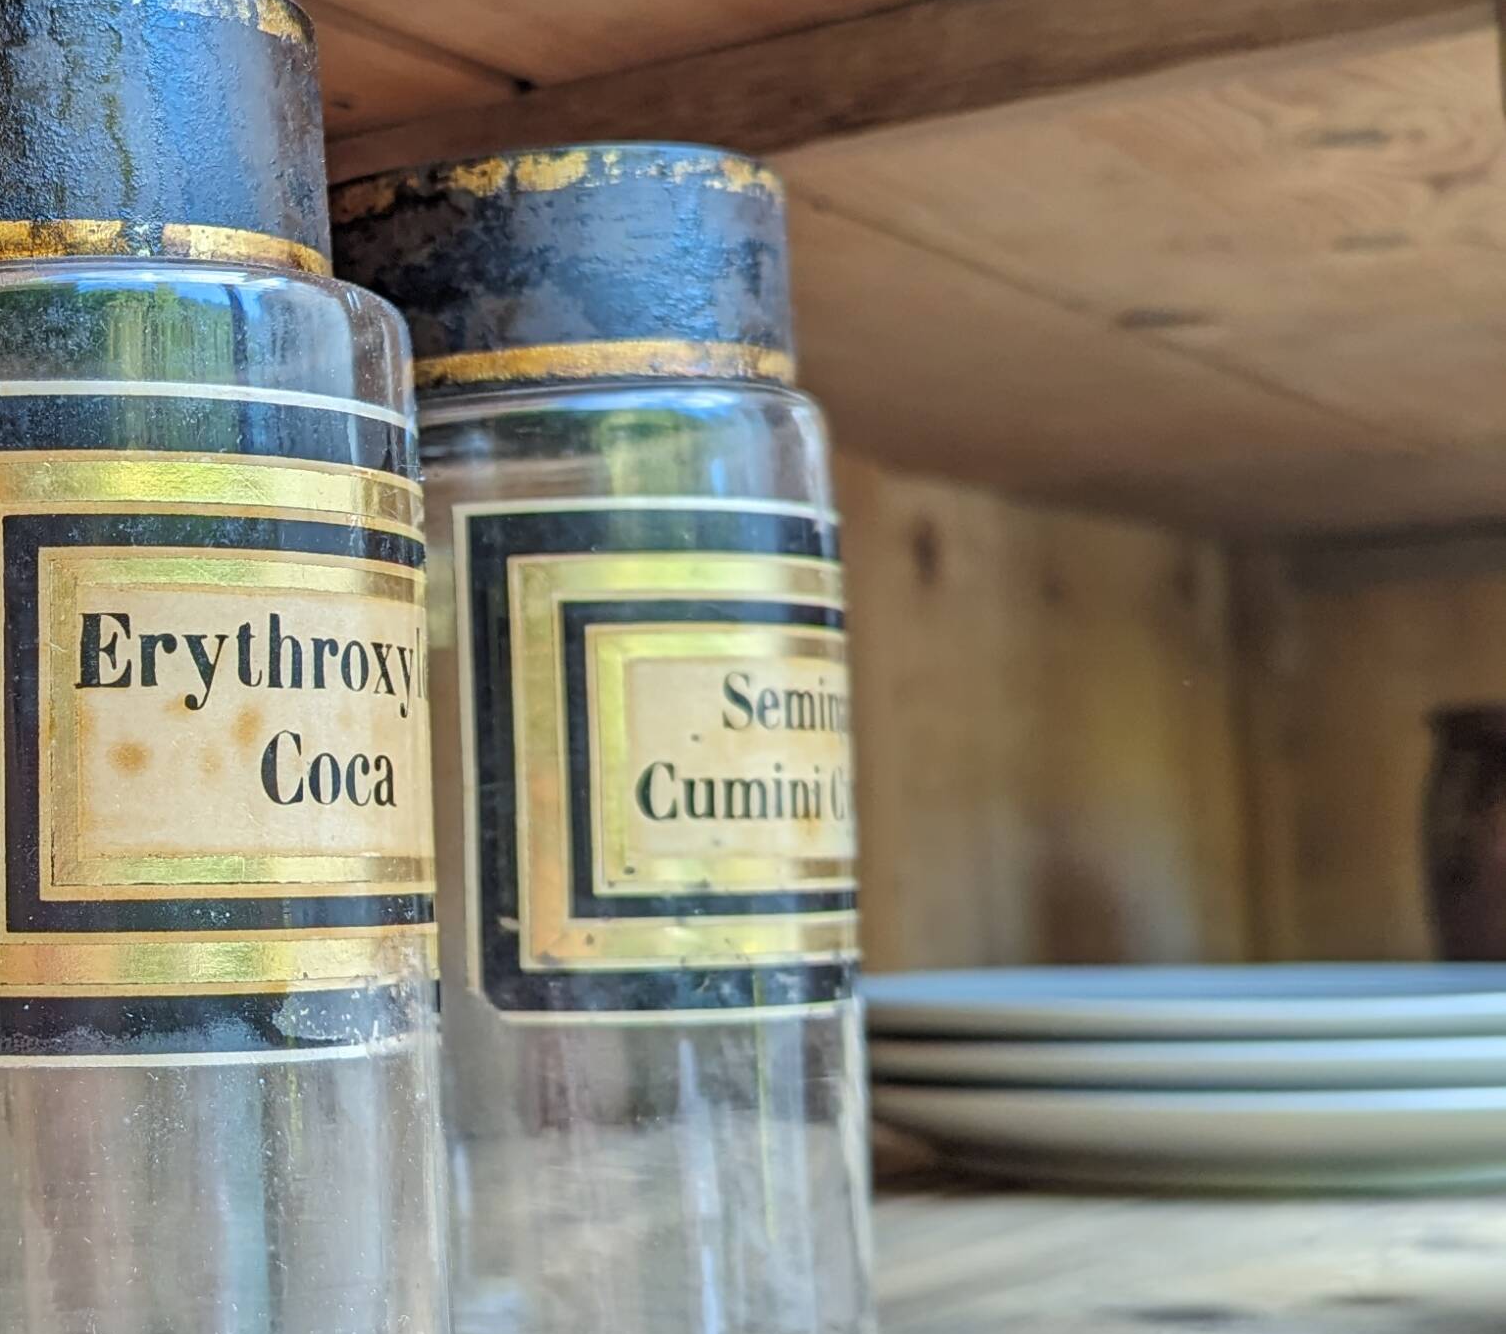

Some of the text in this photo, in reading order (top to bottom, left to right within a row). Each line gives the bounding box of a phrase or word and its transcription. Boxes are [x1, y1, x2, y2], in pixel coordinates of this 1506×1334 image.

[74, 612, 427, 719] Erythroxyl
[722, 670, 848, 732] Semin
[260, 729, 398, 808] Coca
[635, 760, 822, 822] Cumini
